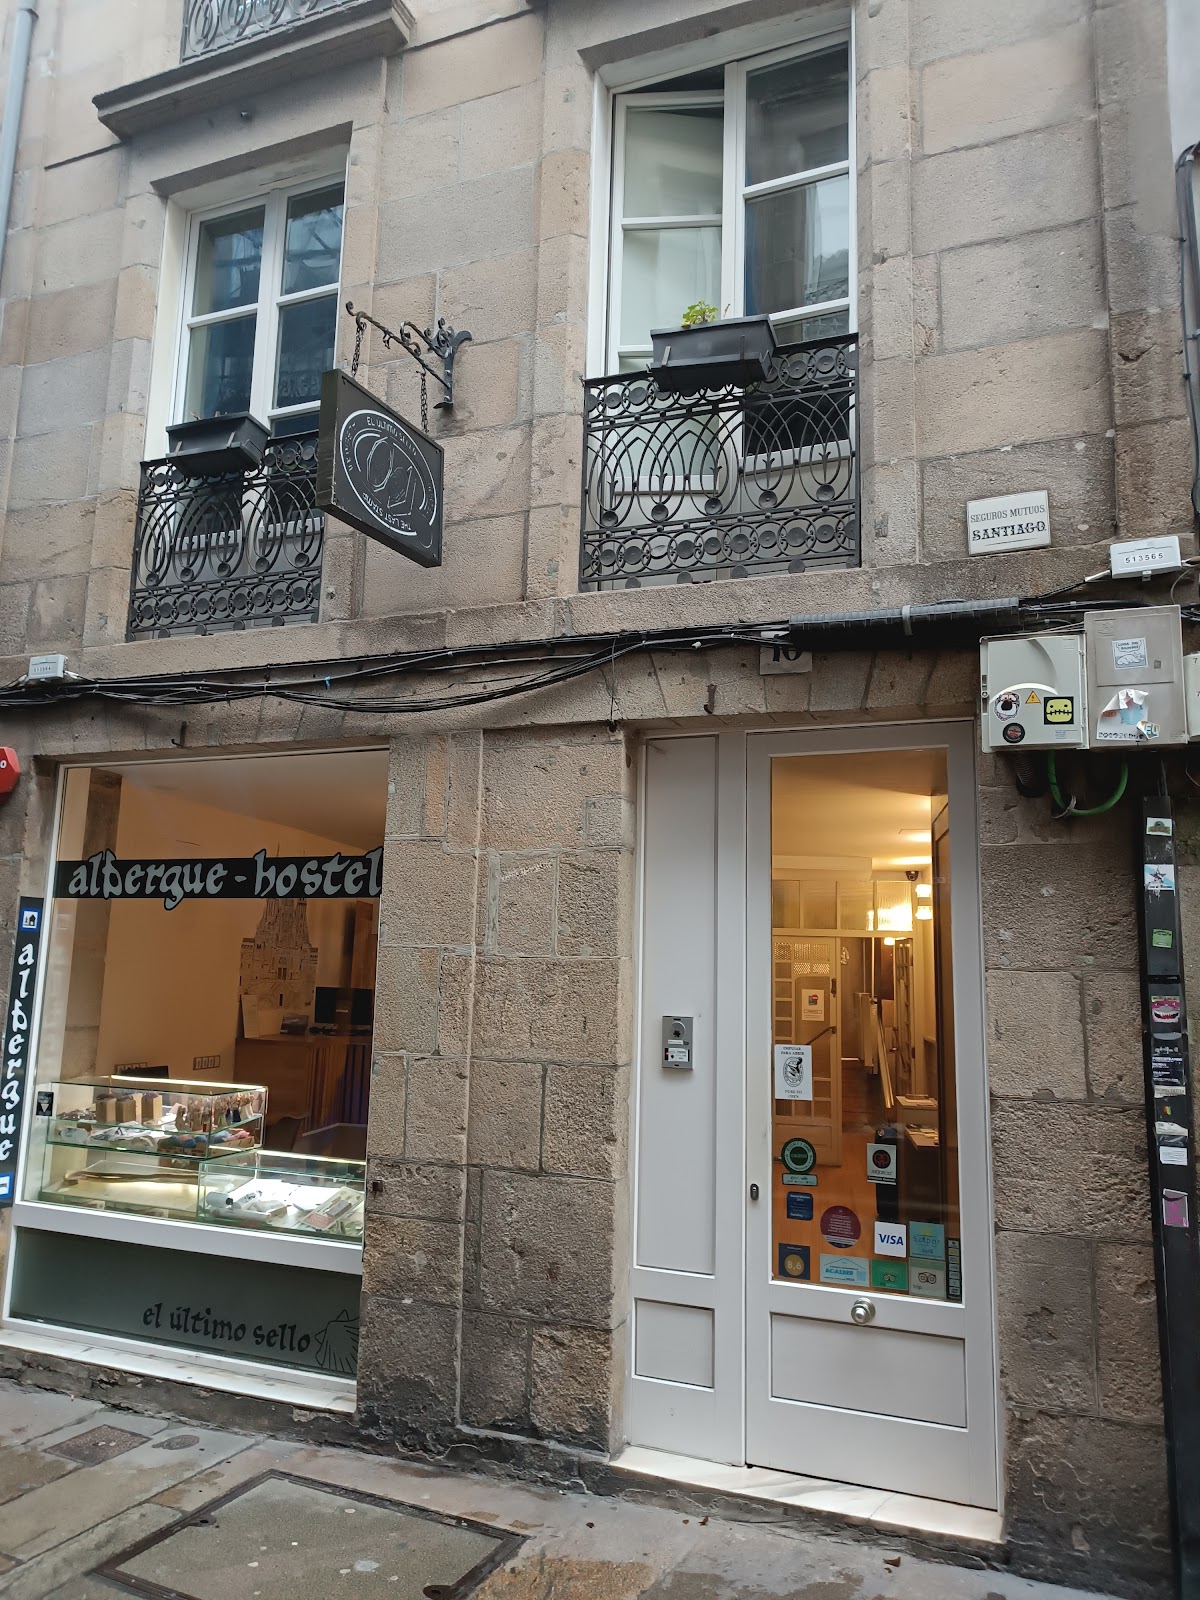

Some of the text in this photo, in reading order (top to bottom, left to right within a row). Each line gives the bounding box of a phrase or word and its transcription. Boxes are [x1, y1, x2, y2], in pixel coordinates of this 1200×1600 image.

[970, 509, 1008, 523] SEGUROS
[1125, 552, 1164, 564] 513565
[68, 848, 229, 910] albergue
[253, 847, 384, 898] hostel
[0, 943, 35, 1162] albergue
[878, 1233, 904, 1246] VISA
[143, 1303, 311, 1353] el último sello
